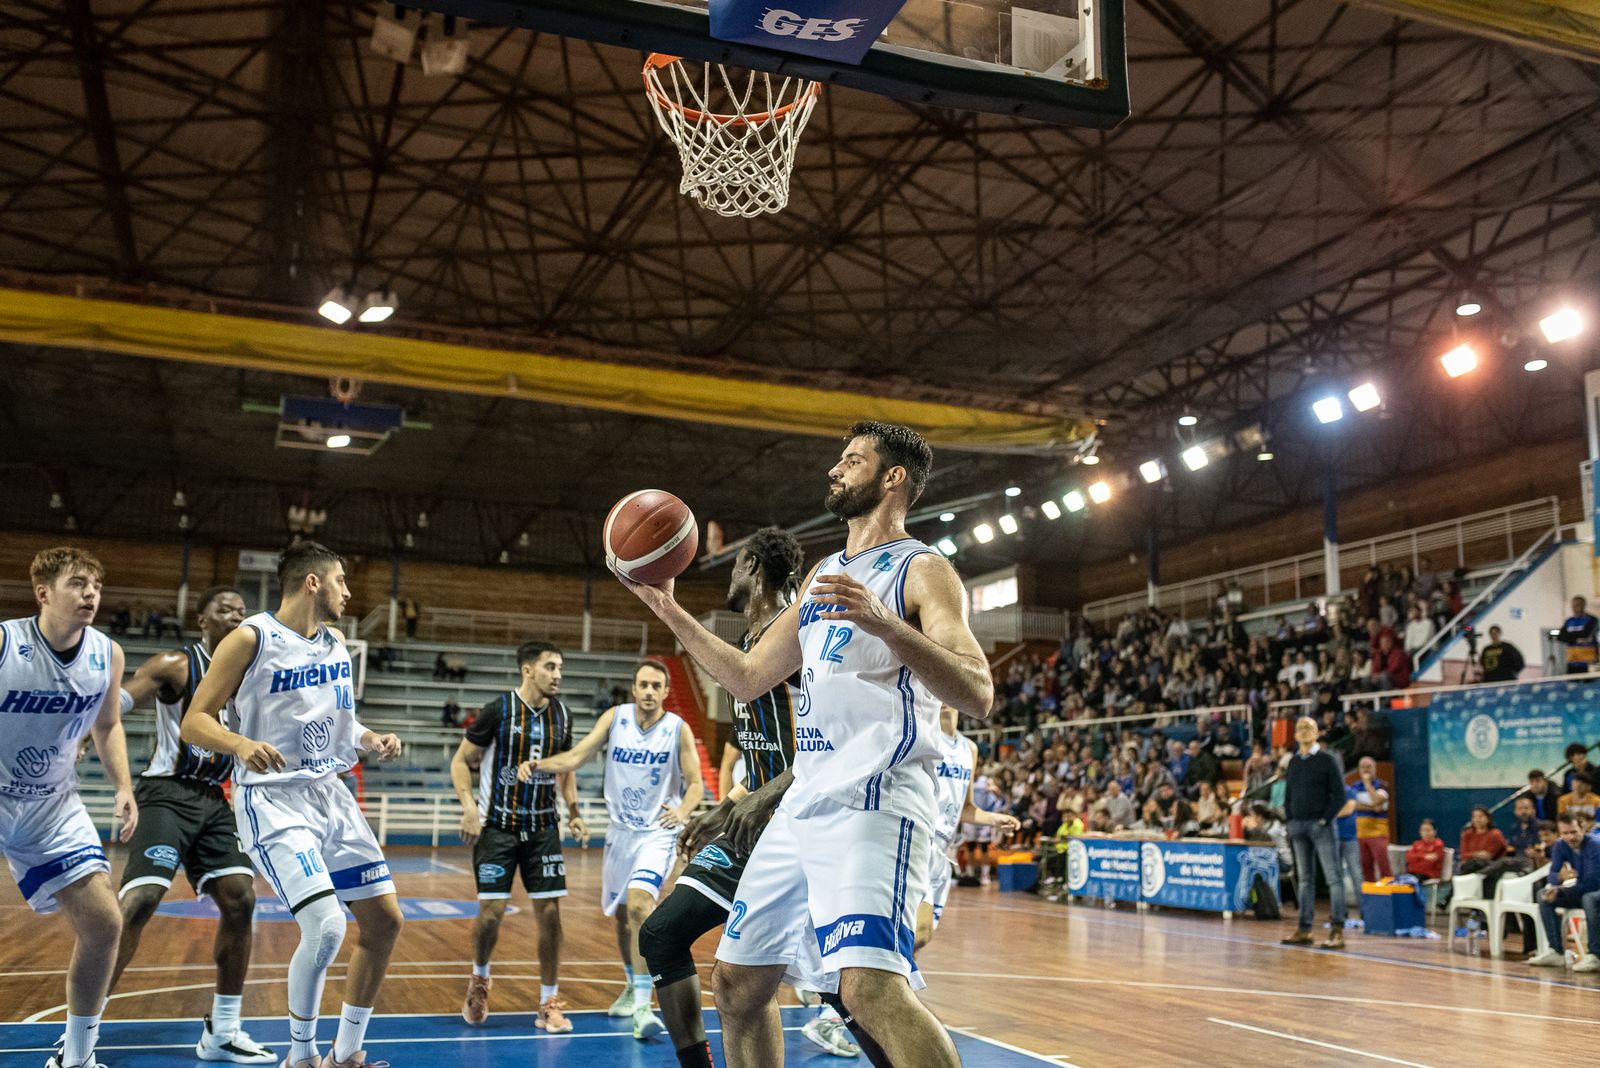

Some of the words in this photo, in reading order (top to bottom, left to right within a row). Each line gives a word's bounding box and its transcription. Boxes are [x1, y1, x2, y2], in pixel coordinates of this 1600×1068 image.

[761, 9, 862, 42] GES
[819, 624, 853, 664] 12
[269, 661, 351, 694] Huelva
[334, 684, 353, 710] 10
[612, 746, 670, 765] Huelva
[650, 767, 660, 786] 5
[296, 848, 324, 877] 10
[1164, 850, 1224, 865] Ayuntamiento
[1179, 863, 1192, 876] de
[1192, 864, 1223, 878] Huelva
[724, 899, 748, 940] 2
[822, 920, 866, 955] Huelva
